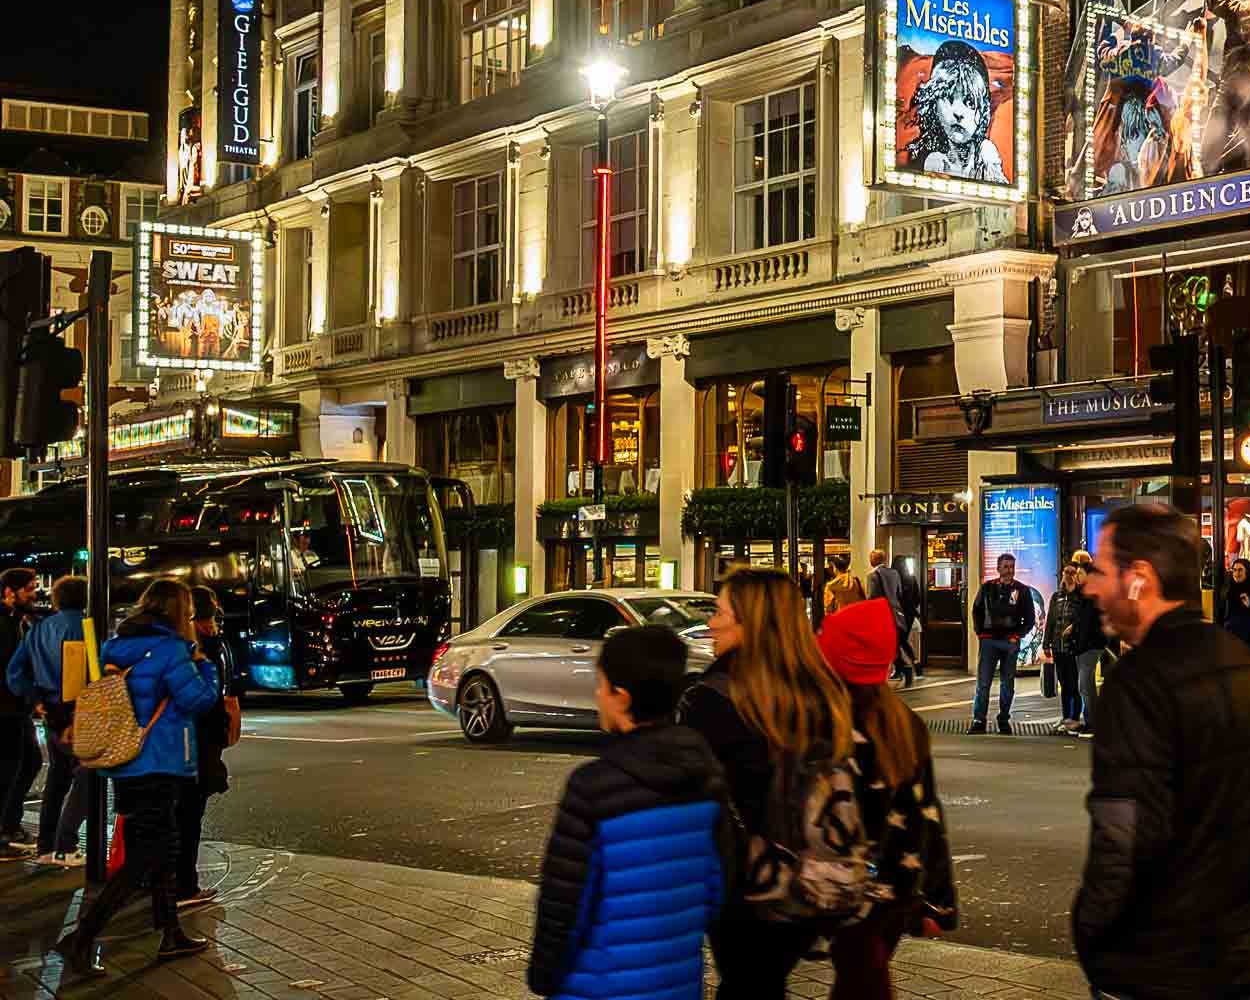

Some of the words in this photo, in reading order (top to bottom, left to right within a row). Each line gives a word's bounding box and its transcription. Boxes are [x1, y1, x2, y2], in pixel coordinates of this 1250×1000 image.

[232, 14, 250, 143] GIELGUD
[223, 144, 258, 156] THEATRE
[161, 259, 240, 284] SWEAT
[1048, 398, 1080, 417] THE
[1085, 392, 1163, 413] MUSICA
[984, 497, 999, 511] Les
